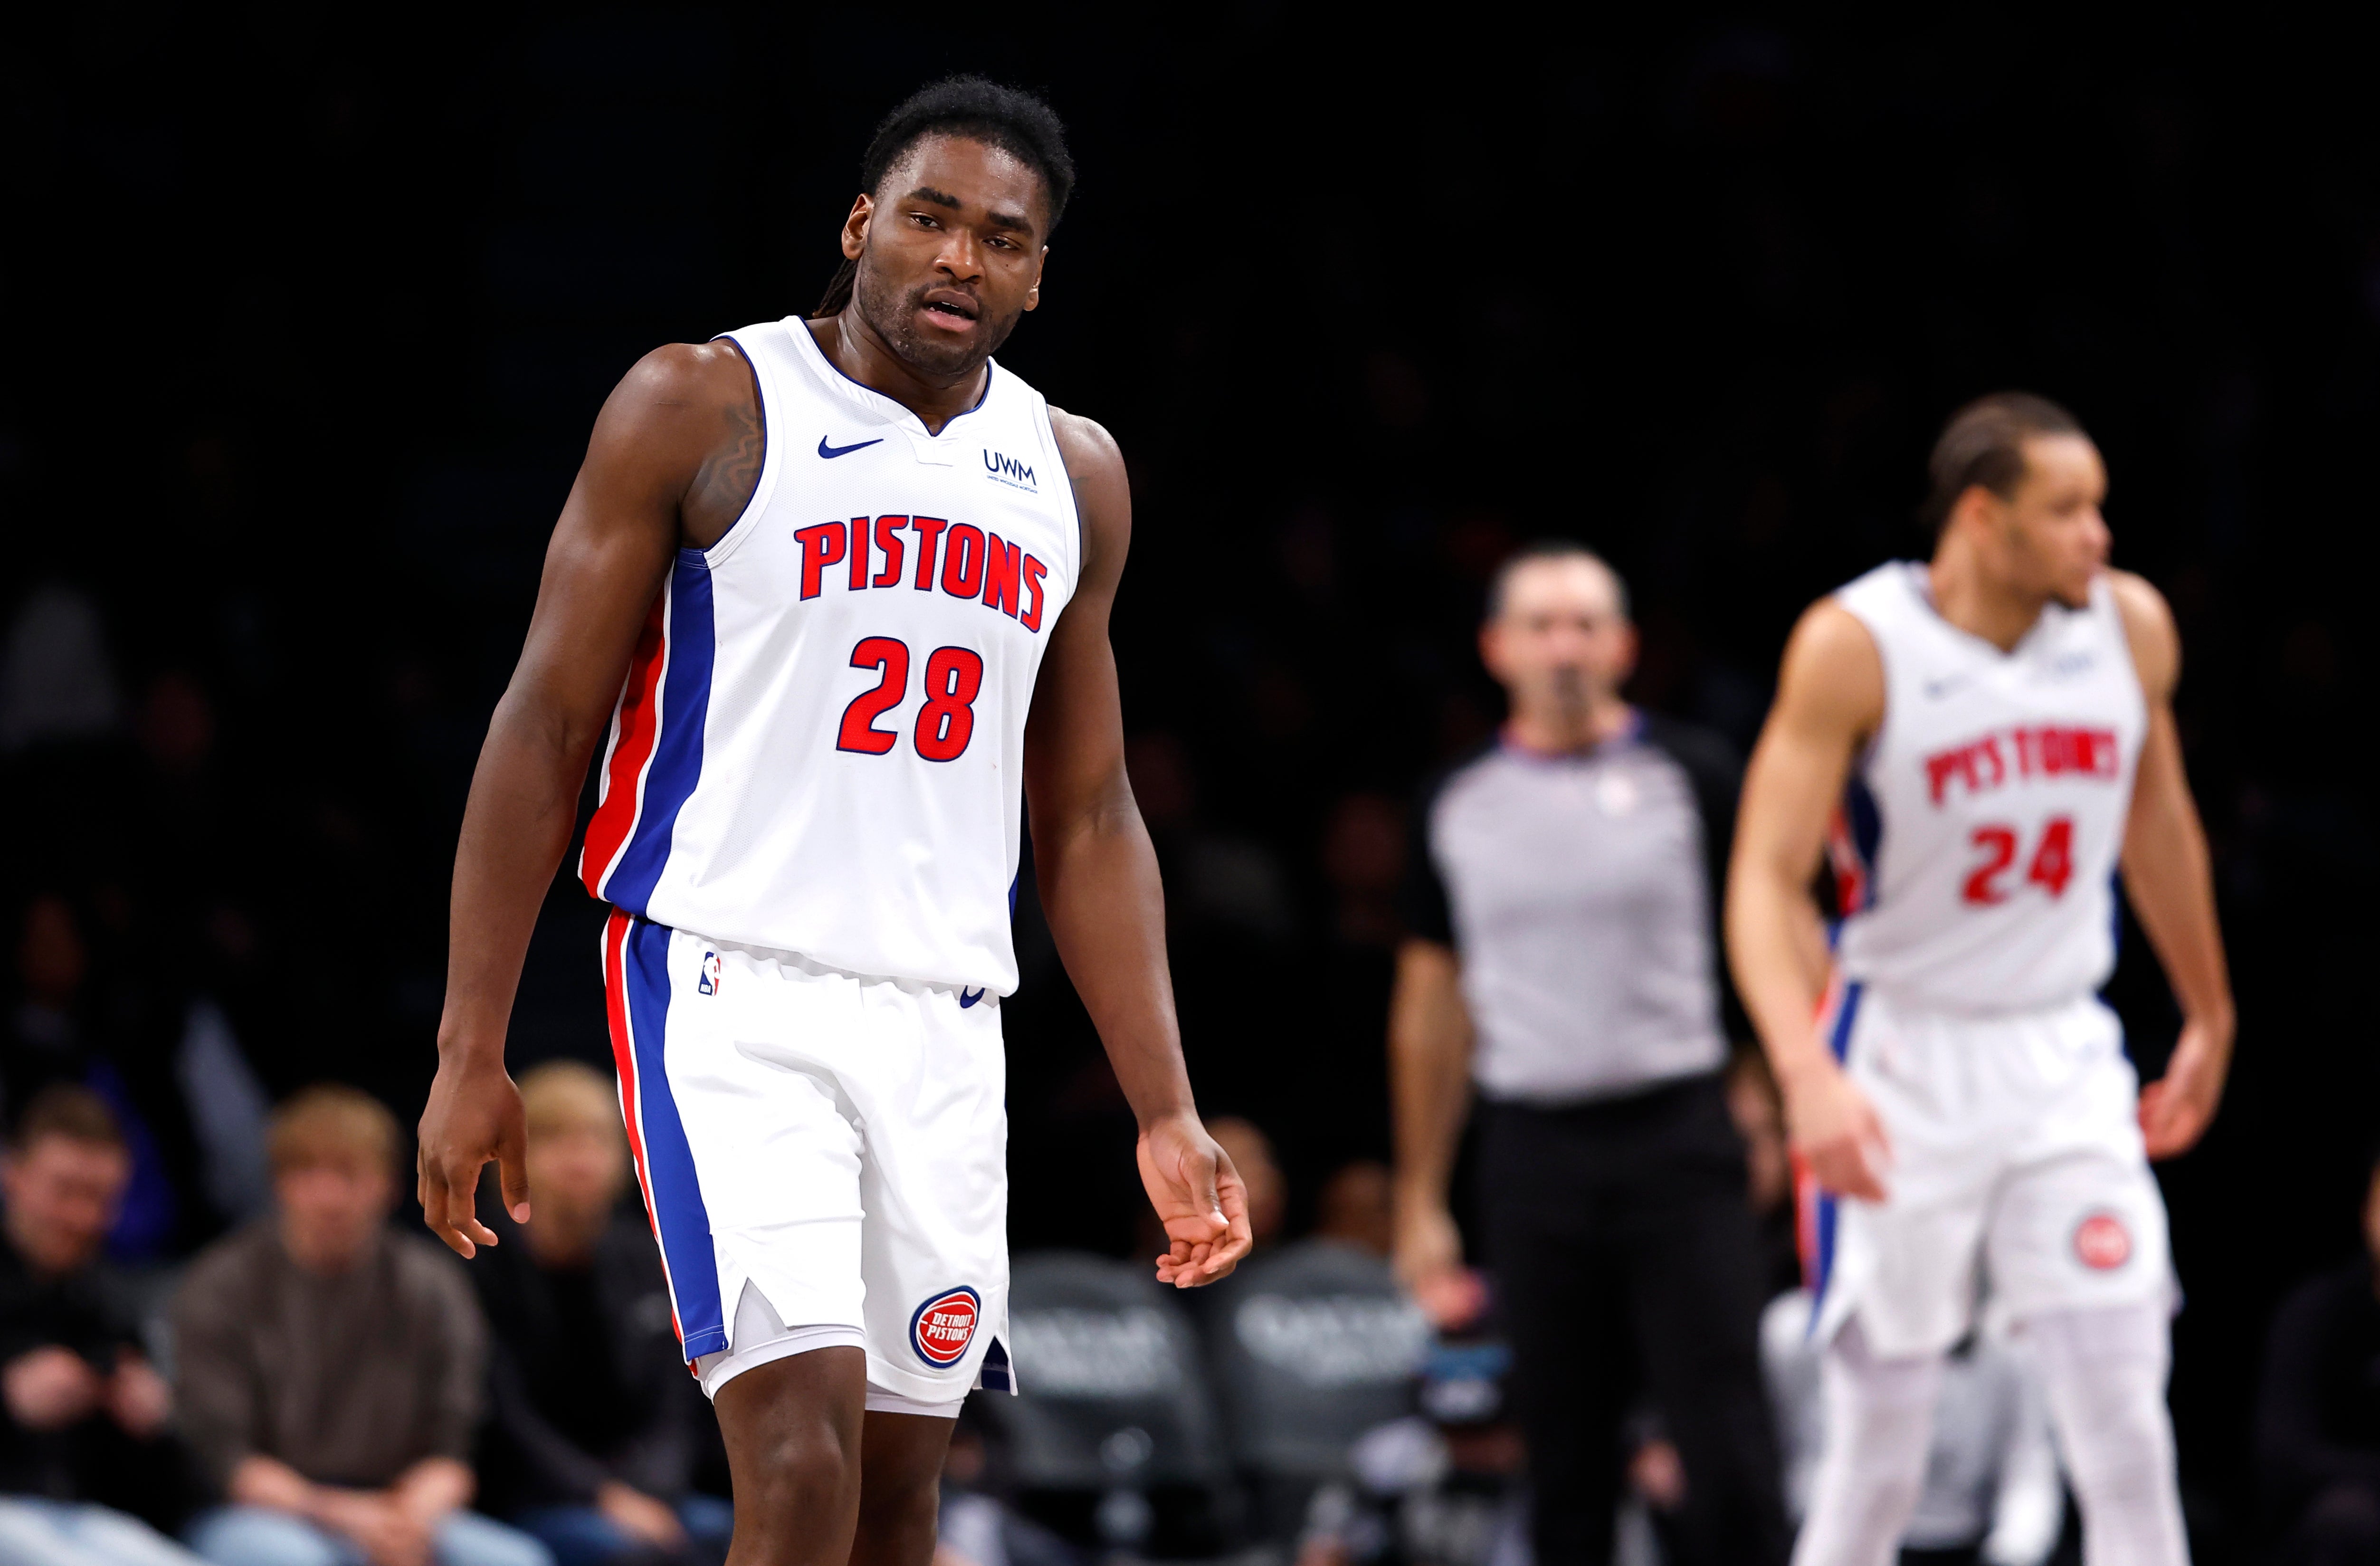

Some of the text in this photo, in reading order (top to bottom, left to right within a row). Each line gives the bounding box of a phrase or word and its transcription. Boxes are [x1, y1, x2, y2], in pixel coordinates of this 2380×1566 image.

[983, 449, 1037, 486] UWM
[794, 515, 1047, 633] PISTONS
[836, 636, 983, 762] 28
[1961, 814, 2075, 907] 24
[700, 984, 711, 993] NBA
[926, 1324, 970, 1341] PISTONS
[932, 1311, 972, 1327] DETROIT
